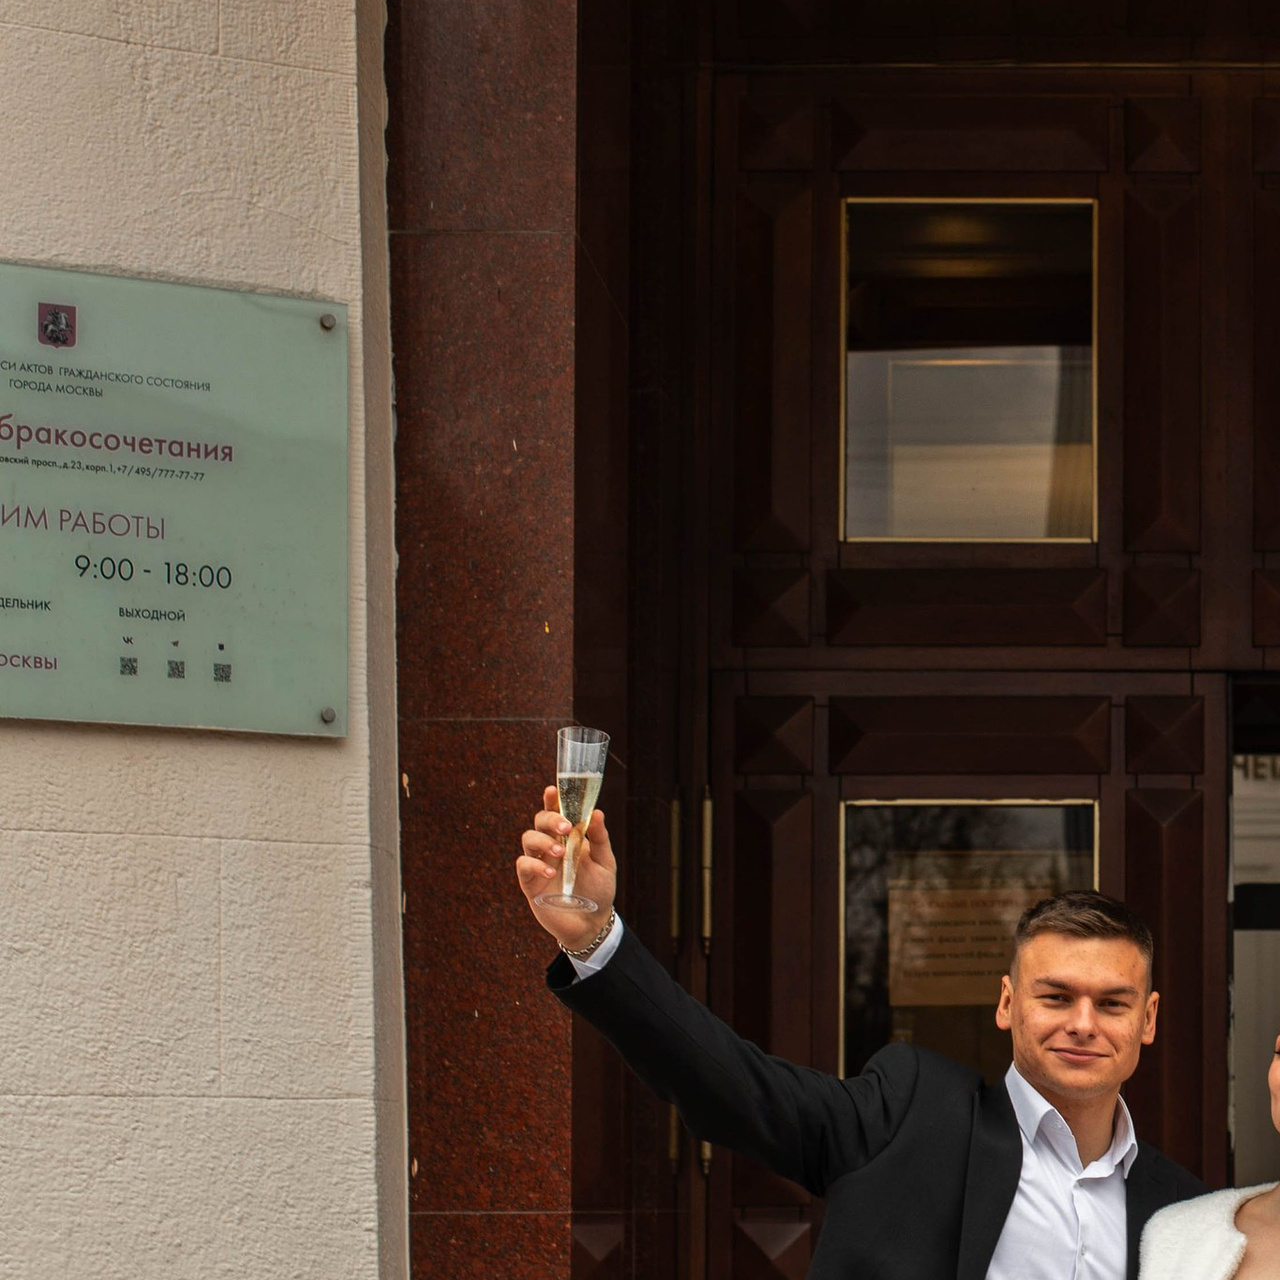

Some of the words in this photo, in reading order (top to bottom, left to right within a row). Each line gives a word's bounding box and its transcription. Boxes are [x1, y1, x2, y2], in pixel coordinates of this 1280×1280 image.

[9, 379, 53, 392] ГОРОДА
[55, 384, 103, 397] МОСКВЫ
[19, 363, 54, 375] АКТОВ
[59, 366, 144, 385] ГРАЖДАНСКОГО
[146, 376, 211, 392] СОСТОЯНИЯ
[0, 413, 233, 462] бракосочетания
[1, 504, 49, 530] ИМ
[59, 509, 165, 540] РАБОТЫ
[75, 554, 134, 581] 9:00
[164, 562, 232, 589] 18:00
[119, 606, 186, 622] ВЫХОДНОЙ
